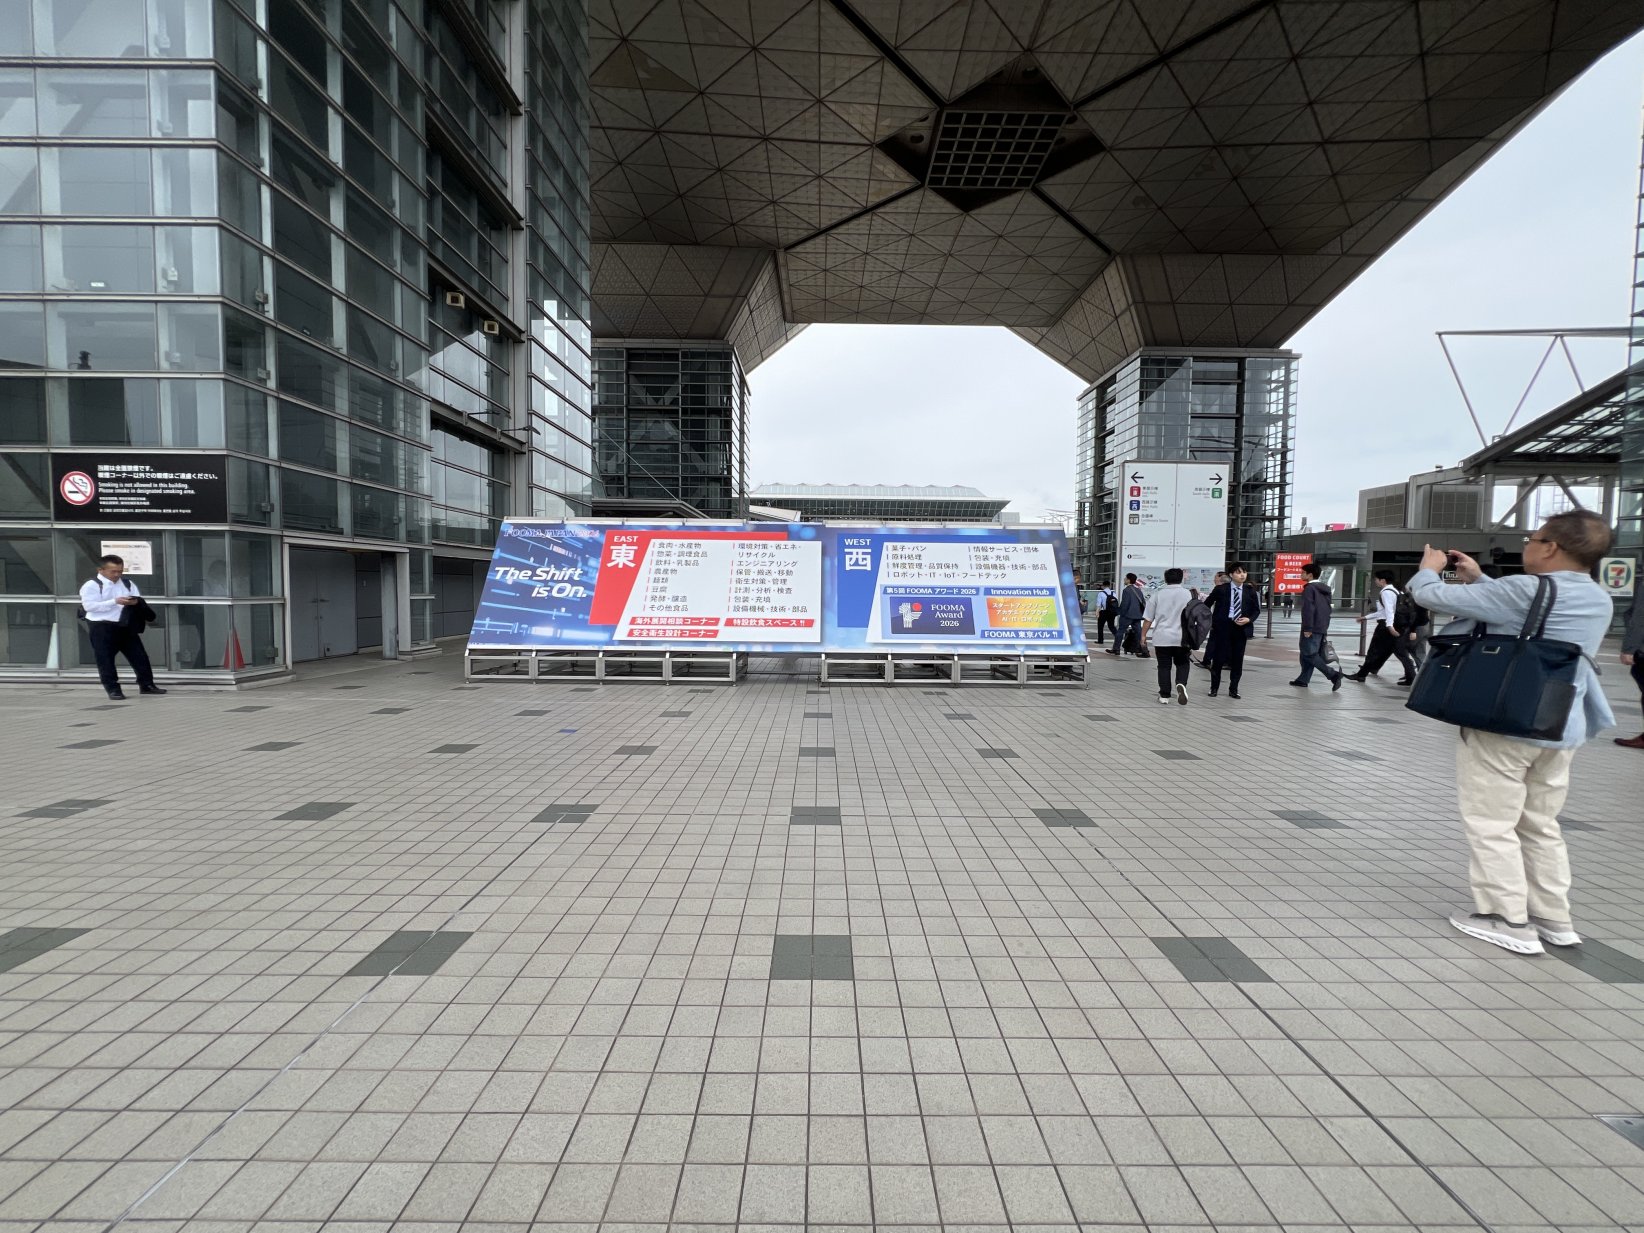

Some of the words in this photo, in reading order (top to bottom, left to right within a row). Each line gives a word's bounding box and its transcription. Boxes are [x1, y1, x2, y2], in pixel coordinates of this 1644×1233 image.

[606, 544, 638, 568] 東
[844, 548, 872, 570] 西
[495, 567, 532, 580] The
[533, 566, 583, 580] Shift
[532, 584, 550, 597] is
[552, 583, 587, 598] On.
